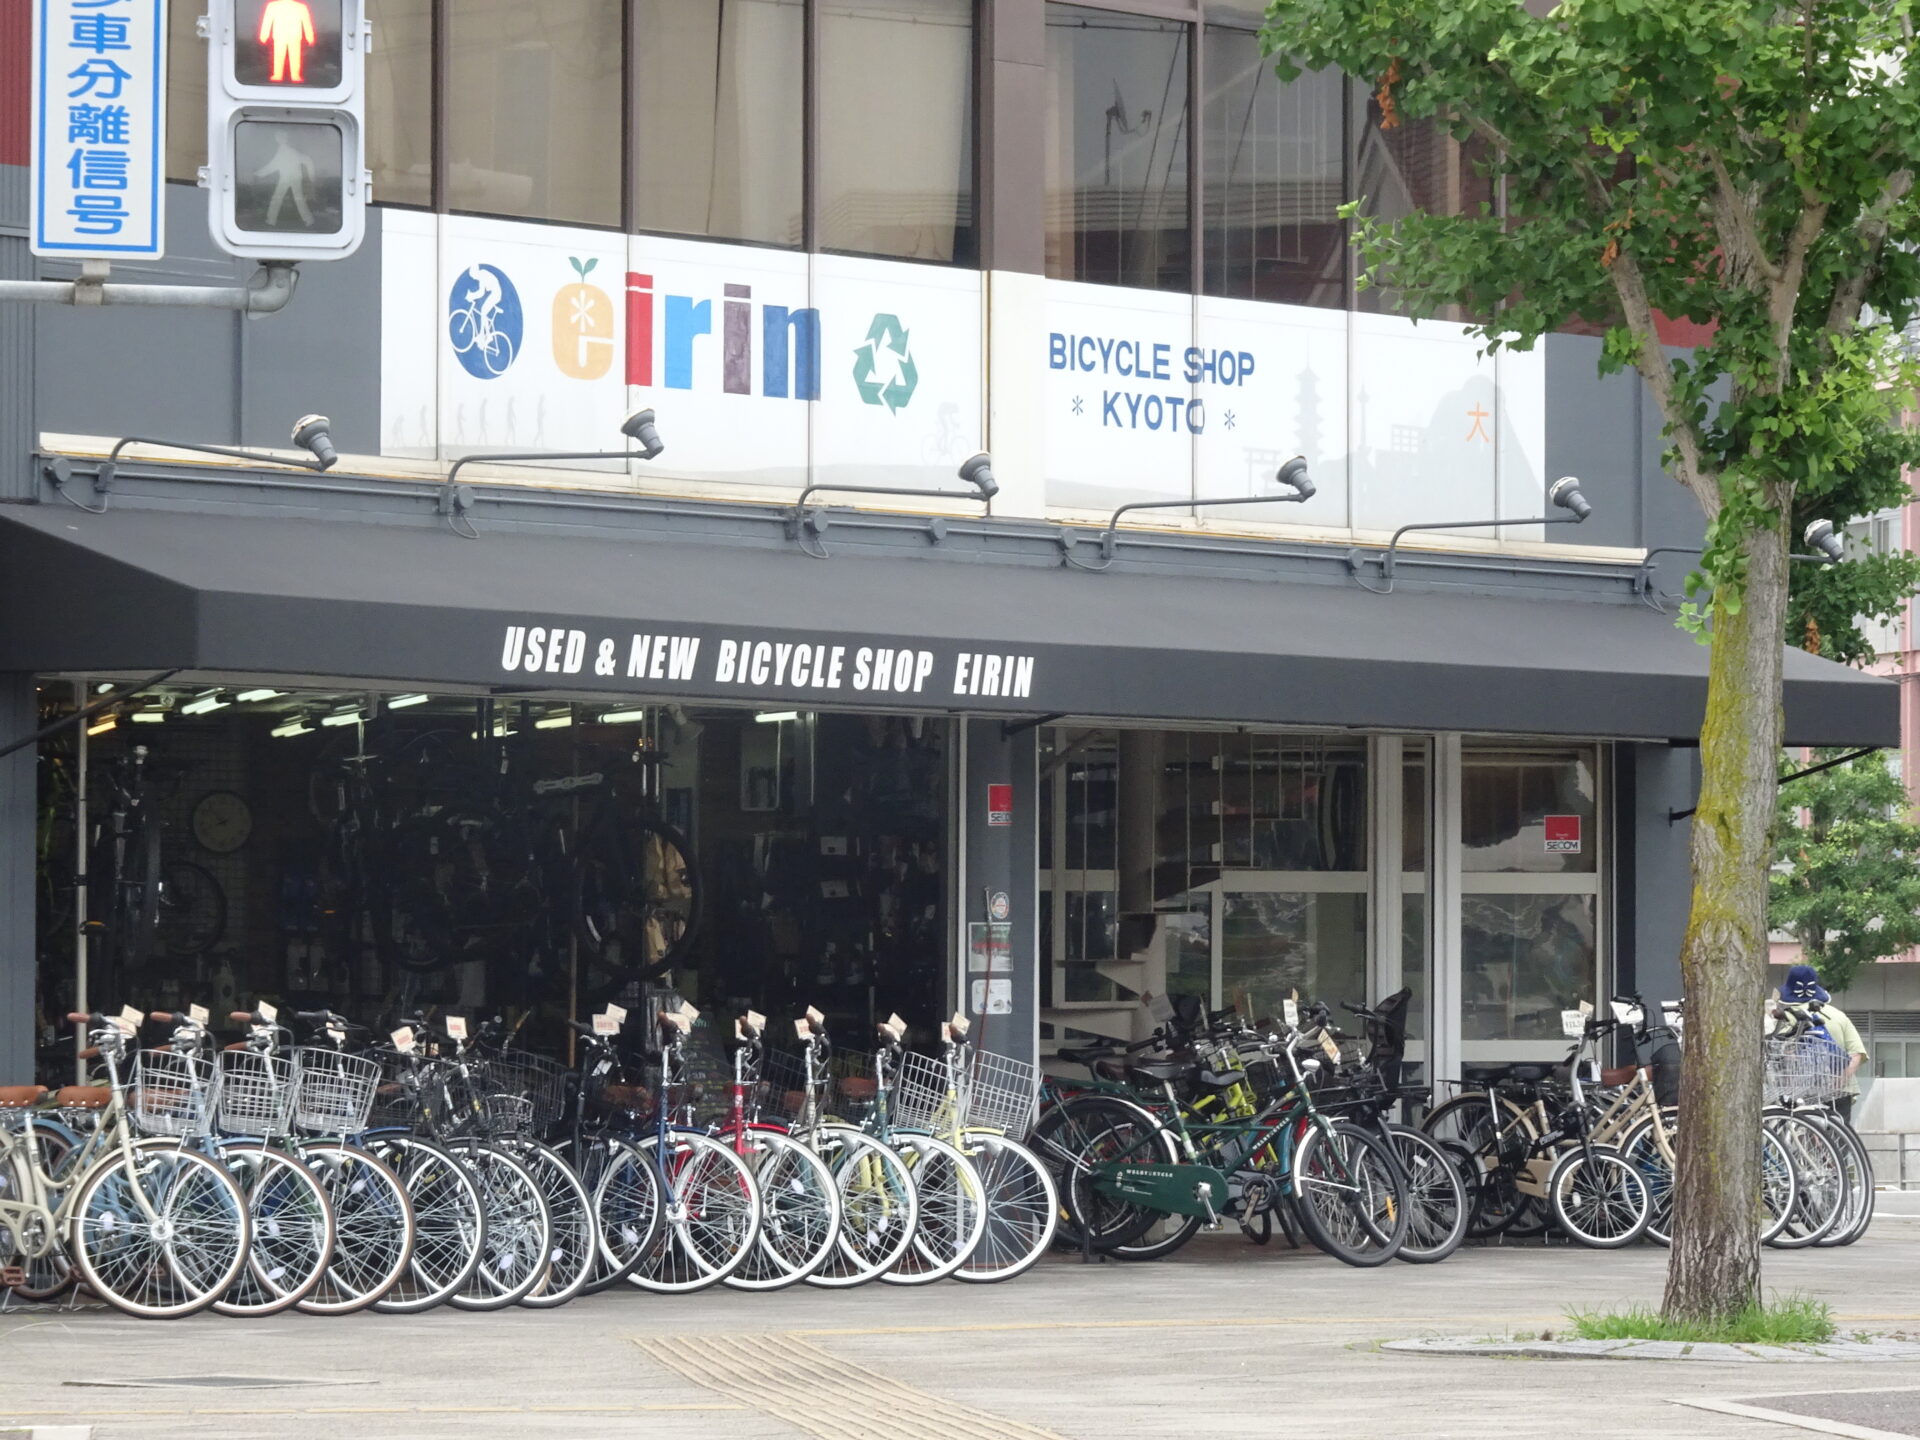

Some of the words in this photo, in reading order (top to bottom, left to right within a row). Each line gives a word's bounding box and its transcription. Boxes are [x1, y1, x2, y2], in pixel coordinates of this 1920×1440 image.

[67, 0, 132, 235] 車分離信号
[552, 270, 821, 401] eirin
[1049, 332, 1171, 381] BICYCLE
[1183, 347, 1256, 386] SHOP
[1102, 391, 1206, 434] KYOTO
[501, 626, 587, 674] USED
[594, 638, 617, 676] &
[626, 634, 701, 681] NEW
[715, 639, 846, 689] BICYCLE
[852, 646, 934, 693] SHOP
[953, 652, 1035, 698] EIRIN
[1546, 841, 1578, 850] SECOM
